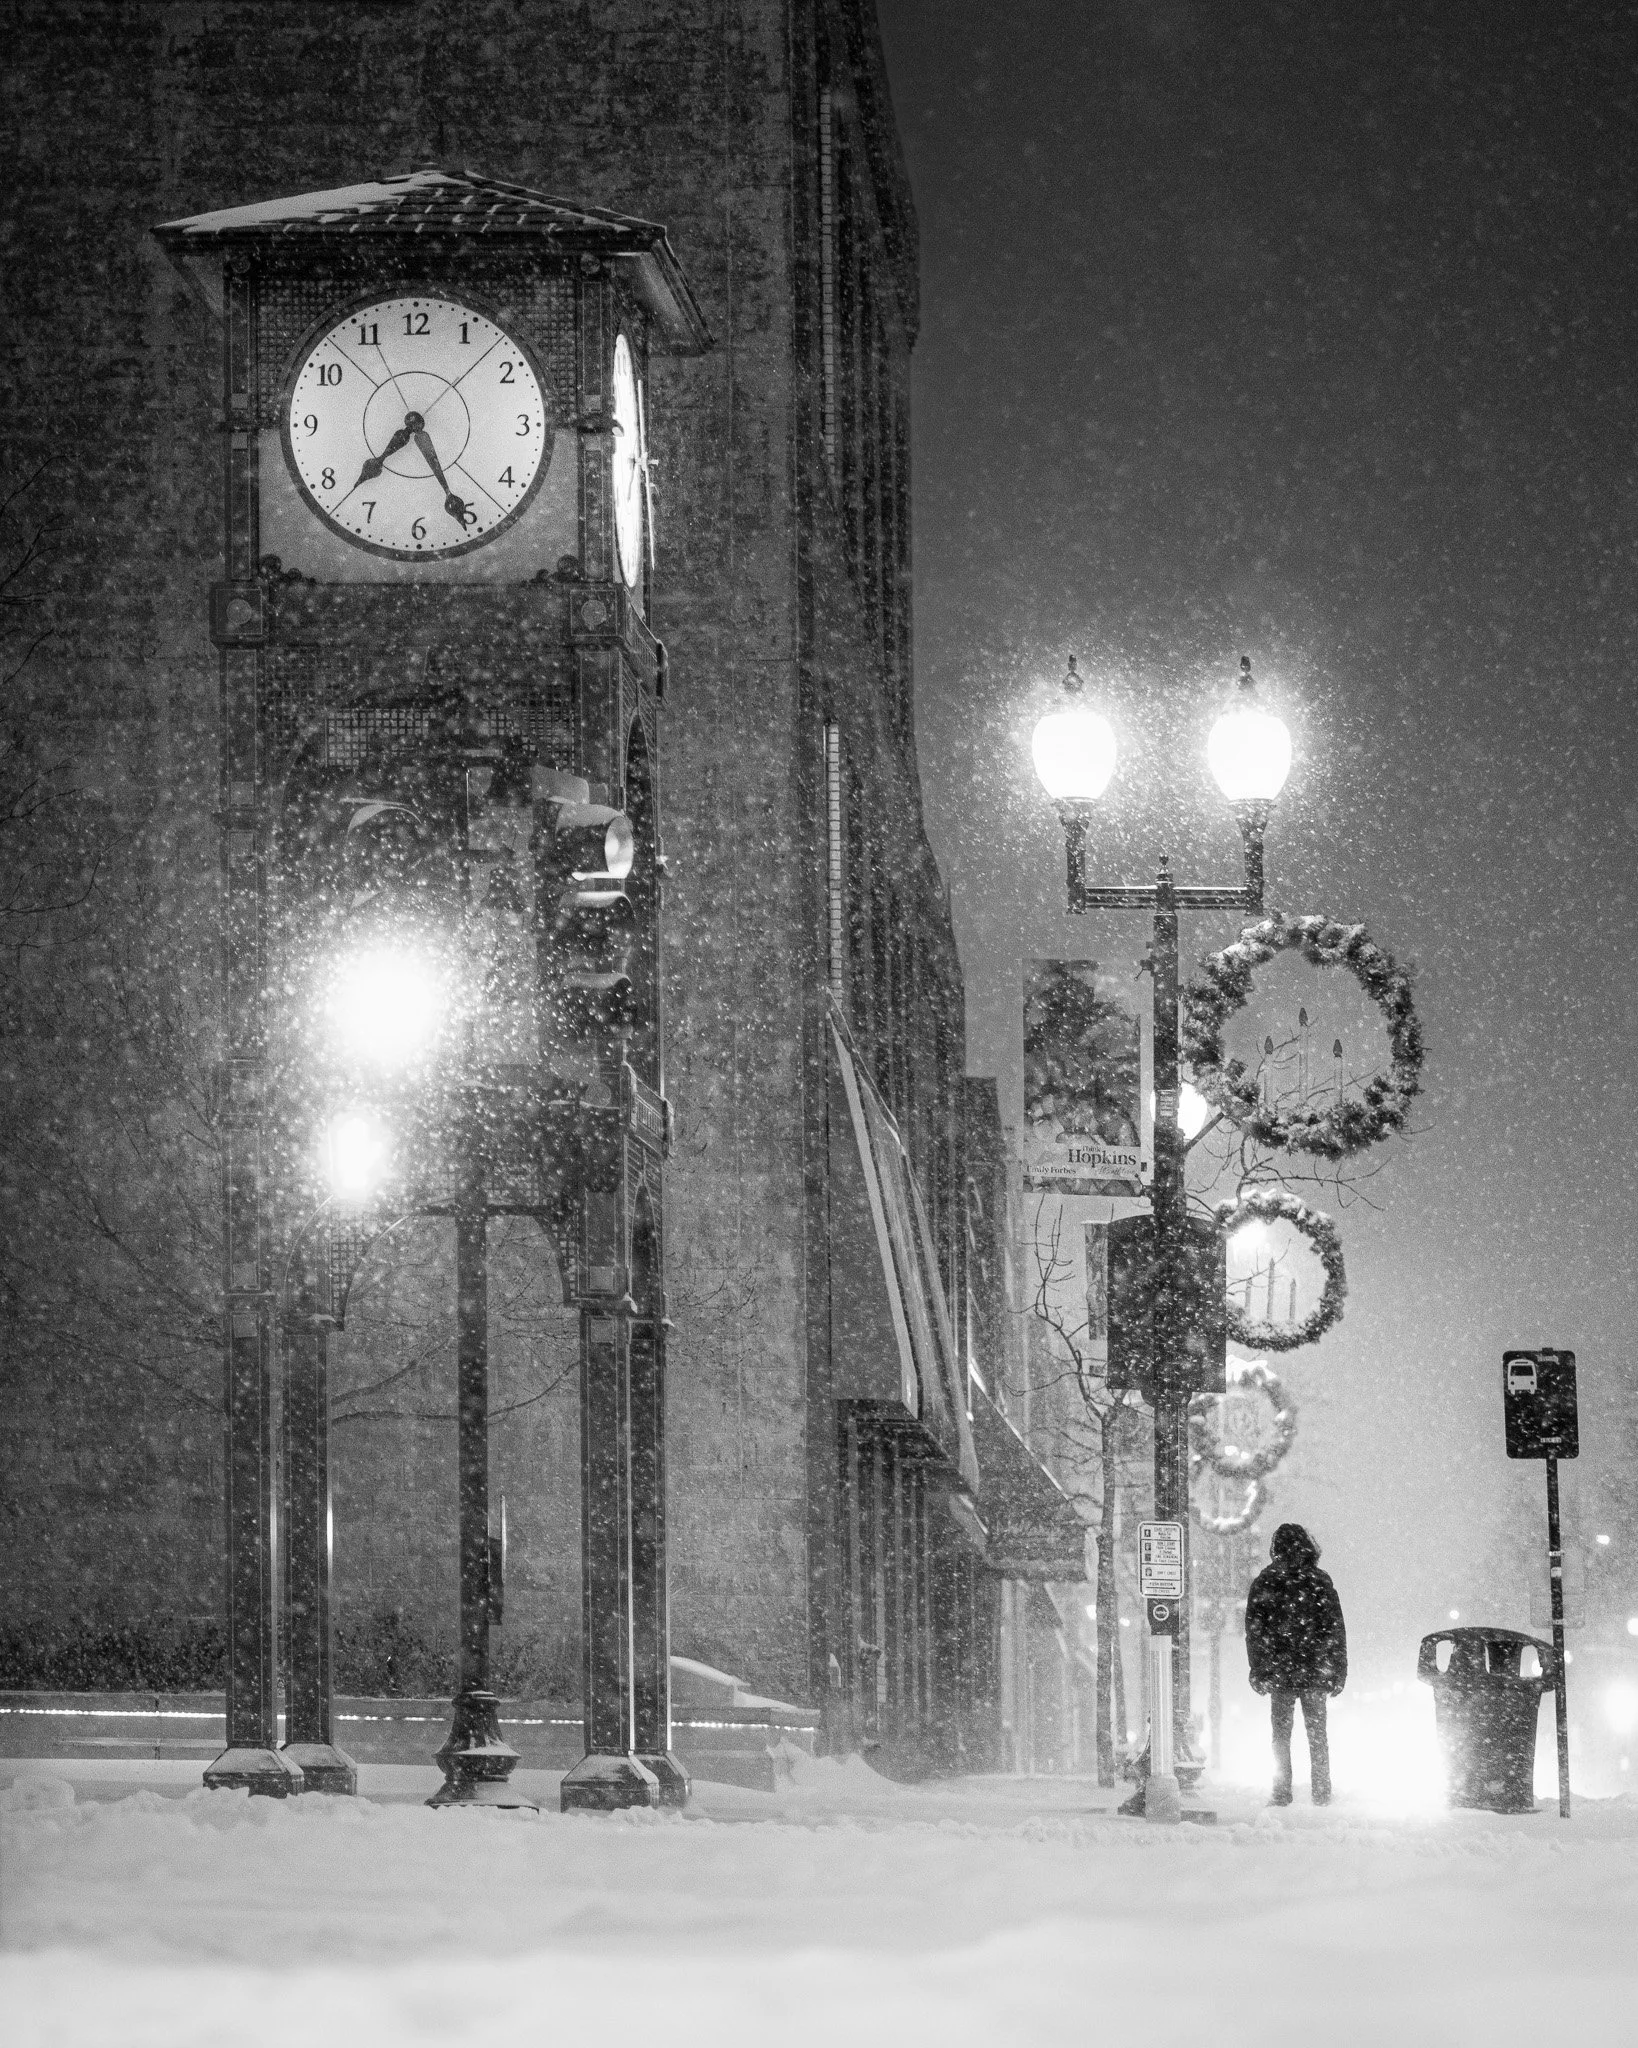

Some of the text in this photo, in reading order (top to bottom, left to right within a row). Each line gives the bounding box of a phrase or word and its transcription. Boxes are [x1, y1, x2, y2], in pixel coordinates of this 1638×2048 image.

[357, 323, 382, 346] 11
[402, 312, 431, 336] 12
[458, 322, 471, 344] 1
[317, 363, 343, 387] 10
[499, 361, 515, 384] 2
[303, 414, 318, 437] 9
[515, 414, 530, 436] 3
[321, 467, 336, 490] 8
[498, 466, 516, 488] 4
[362, 501, 377, 523] 7
[464, 502, 478, 525] 5
[411, 517, 427, 540] 6
[1050, 1166, 1077, 1174] Forbes
[1068, 1149, 1137, 1168] Hopkins
